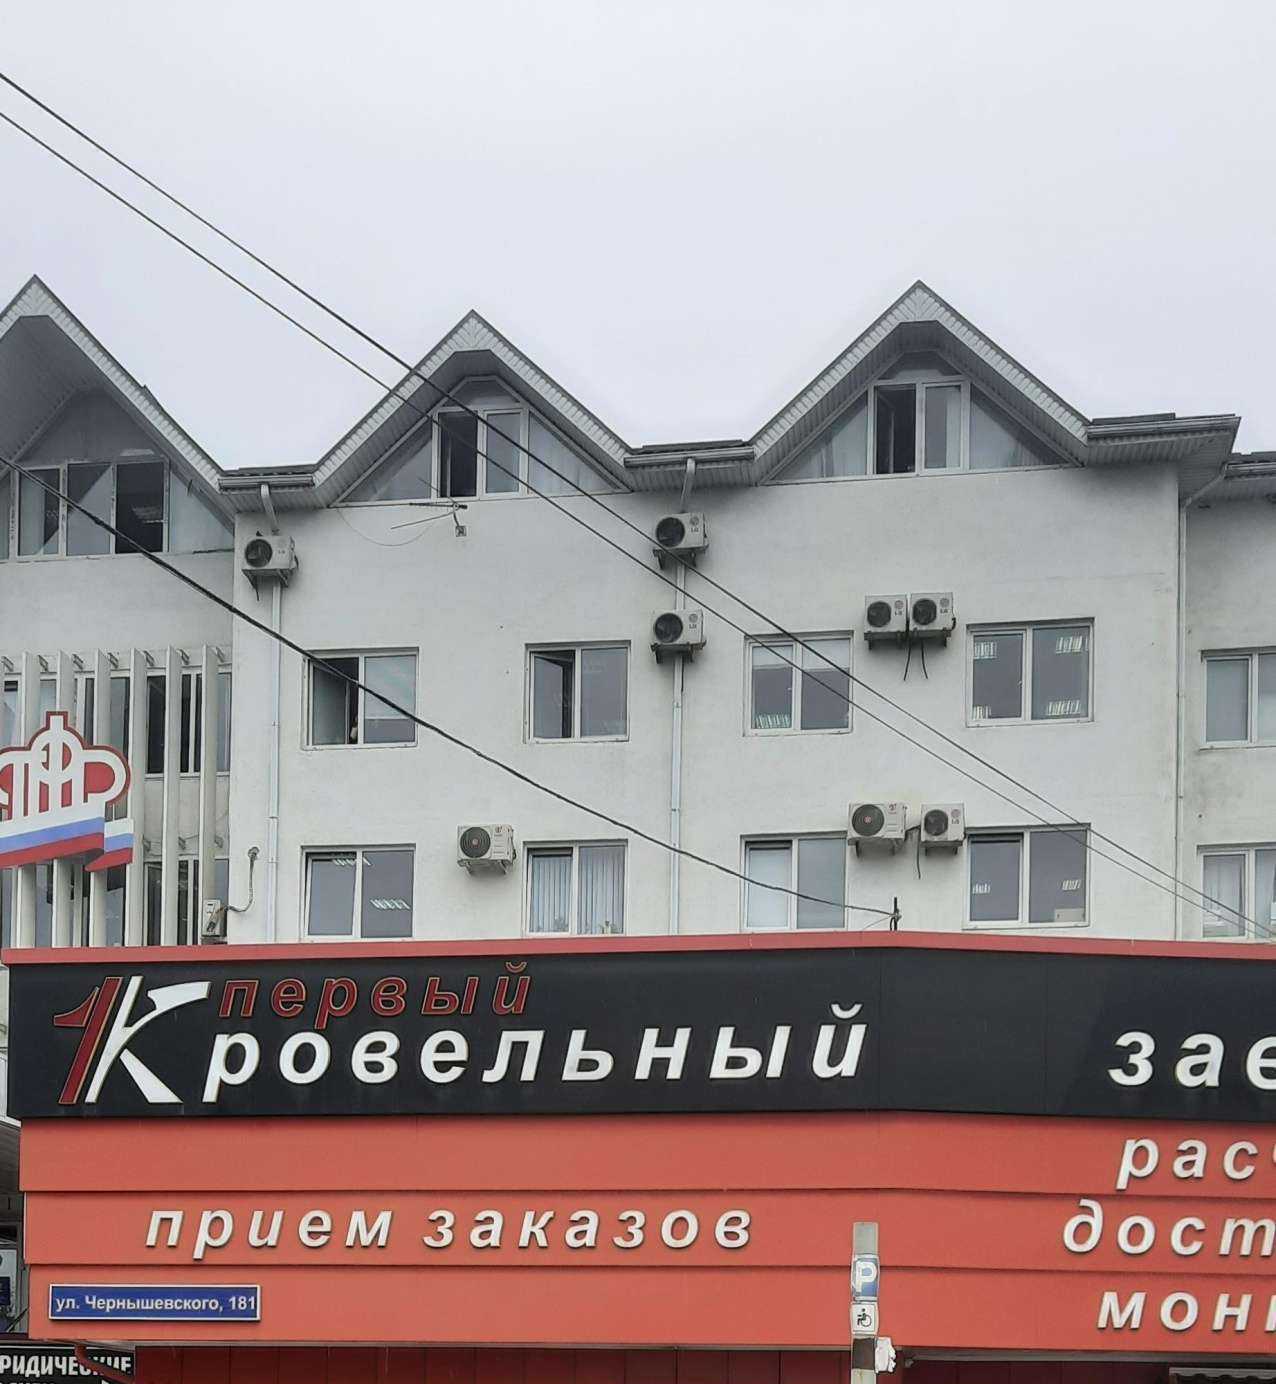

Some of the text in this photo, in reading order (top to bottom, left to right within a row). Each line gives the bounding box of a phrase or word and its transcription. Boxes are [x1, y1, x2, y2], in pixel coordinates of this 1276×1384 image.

[219, 961, 530, 1030] первый
[1115, 1138, 1276, 1190] рас
[145, 1208, 751, 1259] прием заказов
[1063, 1199, 1276, 1257] дост
[56, 1295, 256, 1312] ул. Чернышевского, 181
[1097, 1291, 1276, 1332] мон
